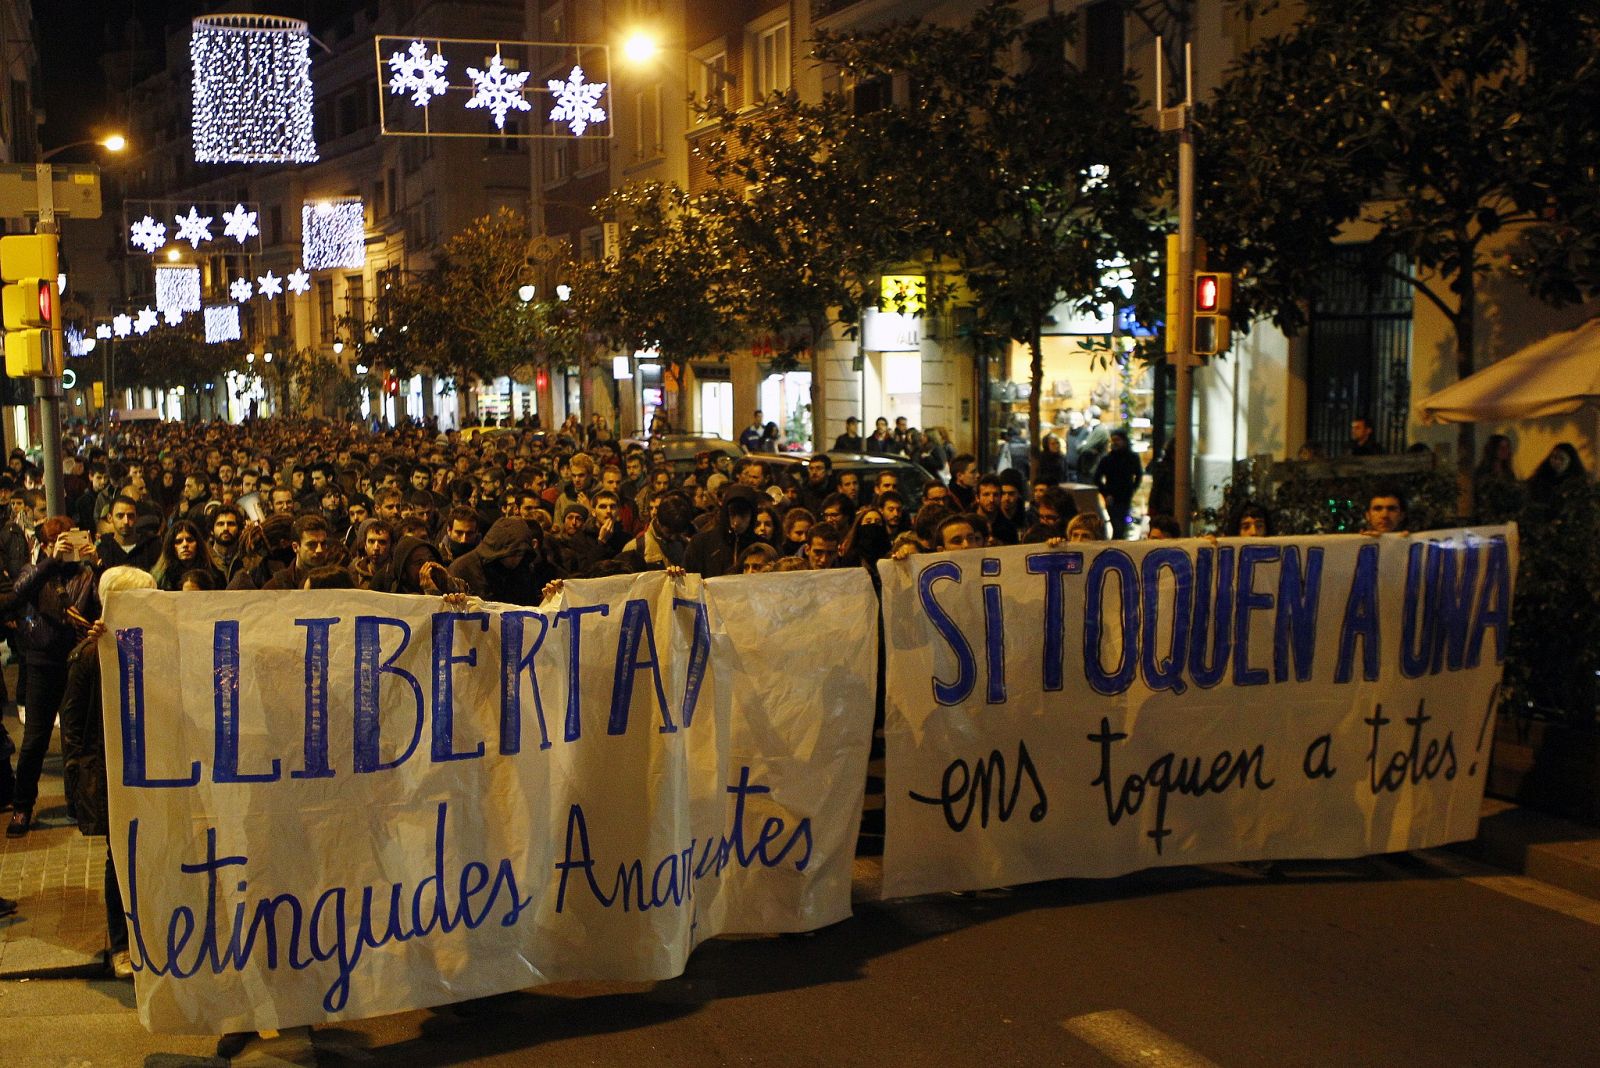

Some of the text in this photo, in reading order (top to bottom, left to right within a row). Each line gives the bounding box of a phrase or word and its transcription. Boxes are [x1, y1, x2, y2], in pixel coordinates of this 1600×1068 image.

[1026, 547, 1325, 696] TOQUEN
[1333, 544, 1381, 684] A
[1401, 534, 1509, 679] UNA
[909, 739, 1048, 832] ens
[1087, 717, 1276, 856] toquen
[1303, 733, 1337, 779] a
